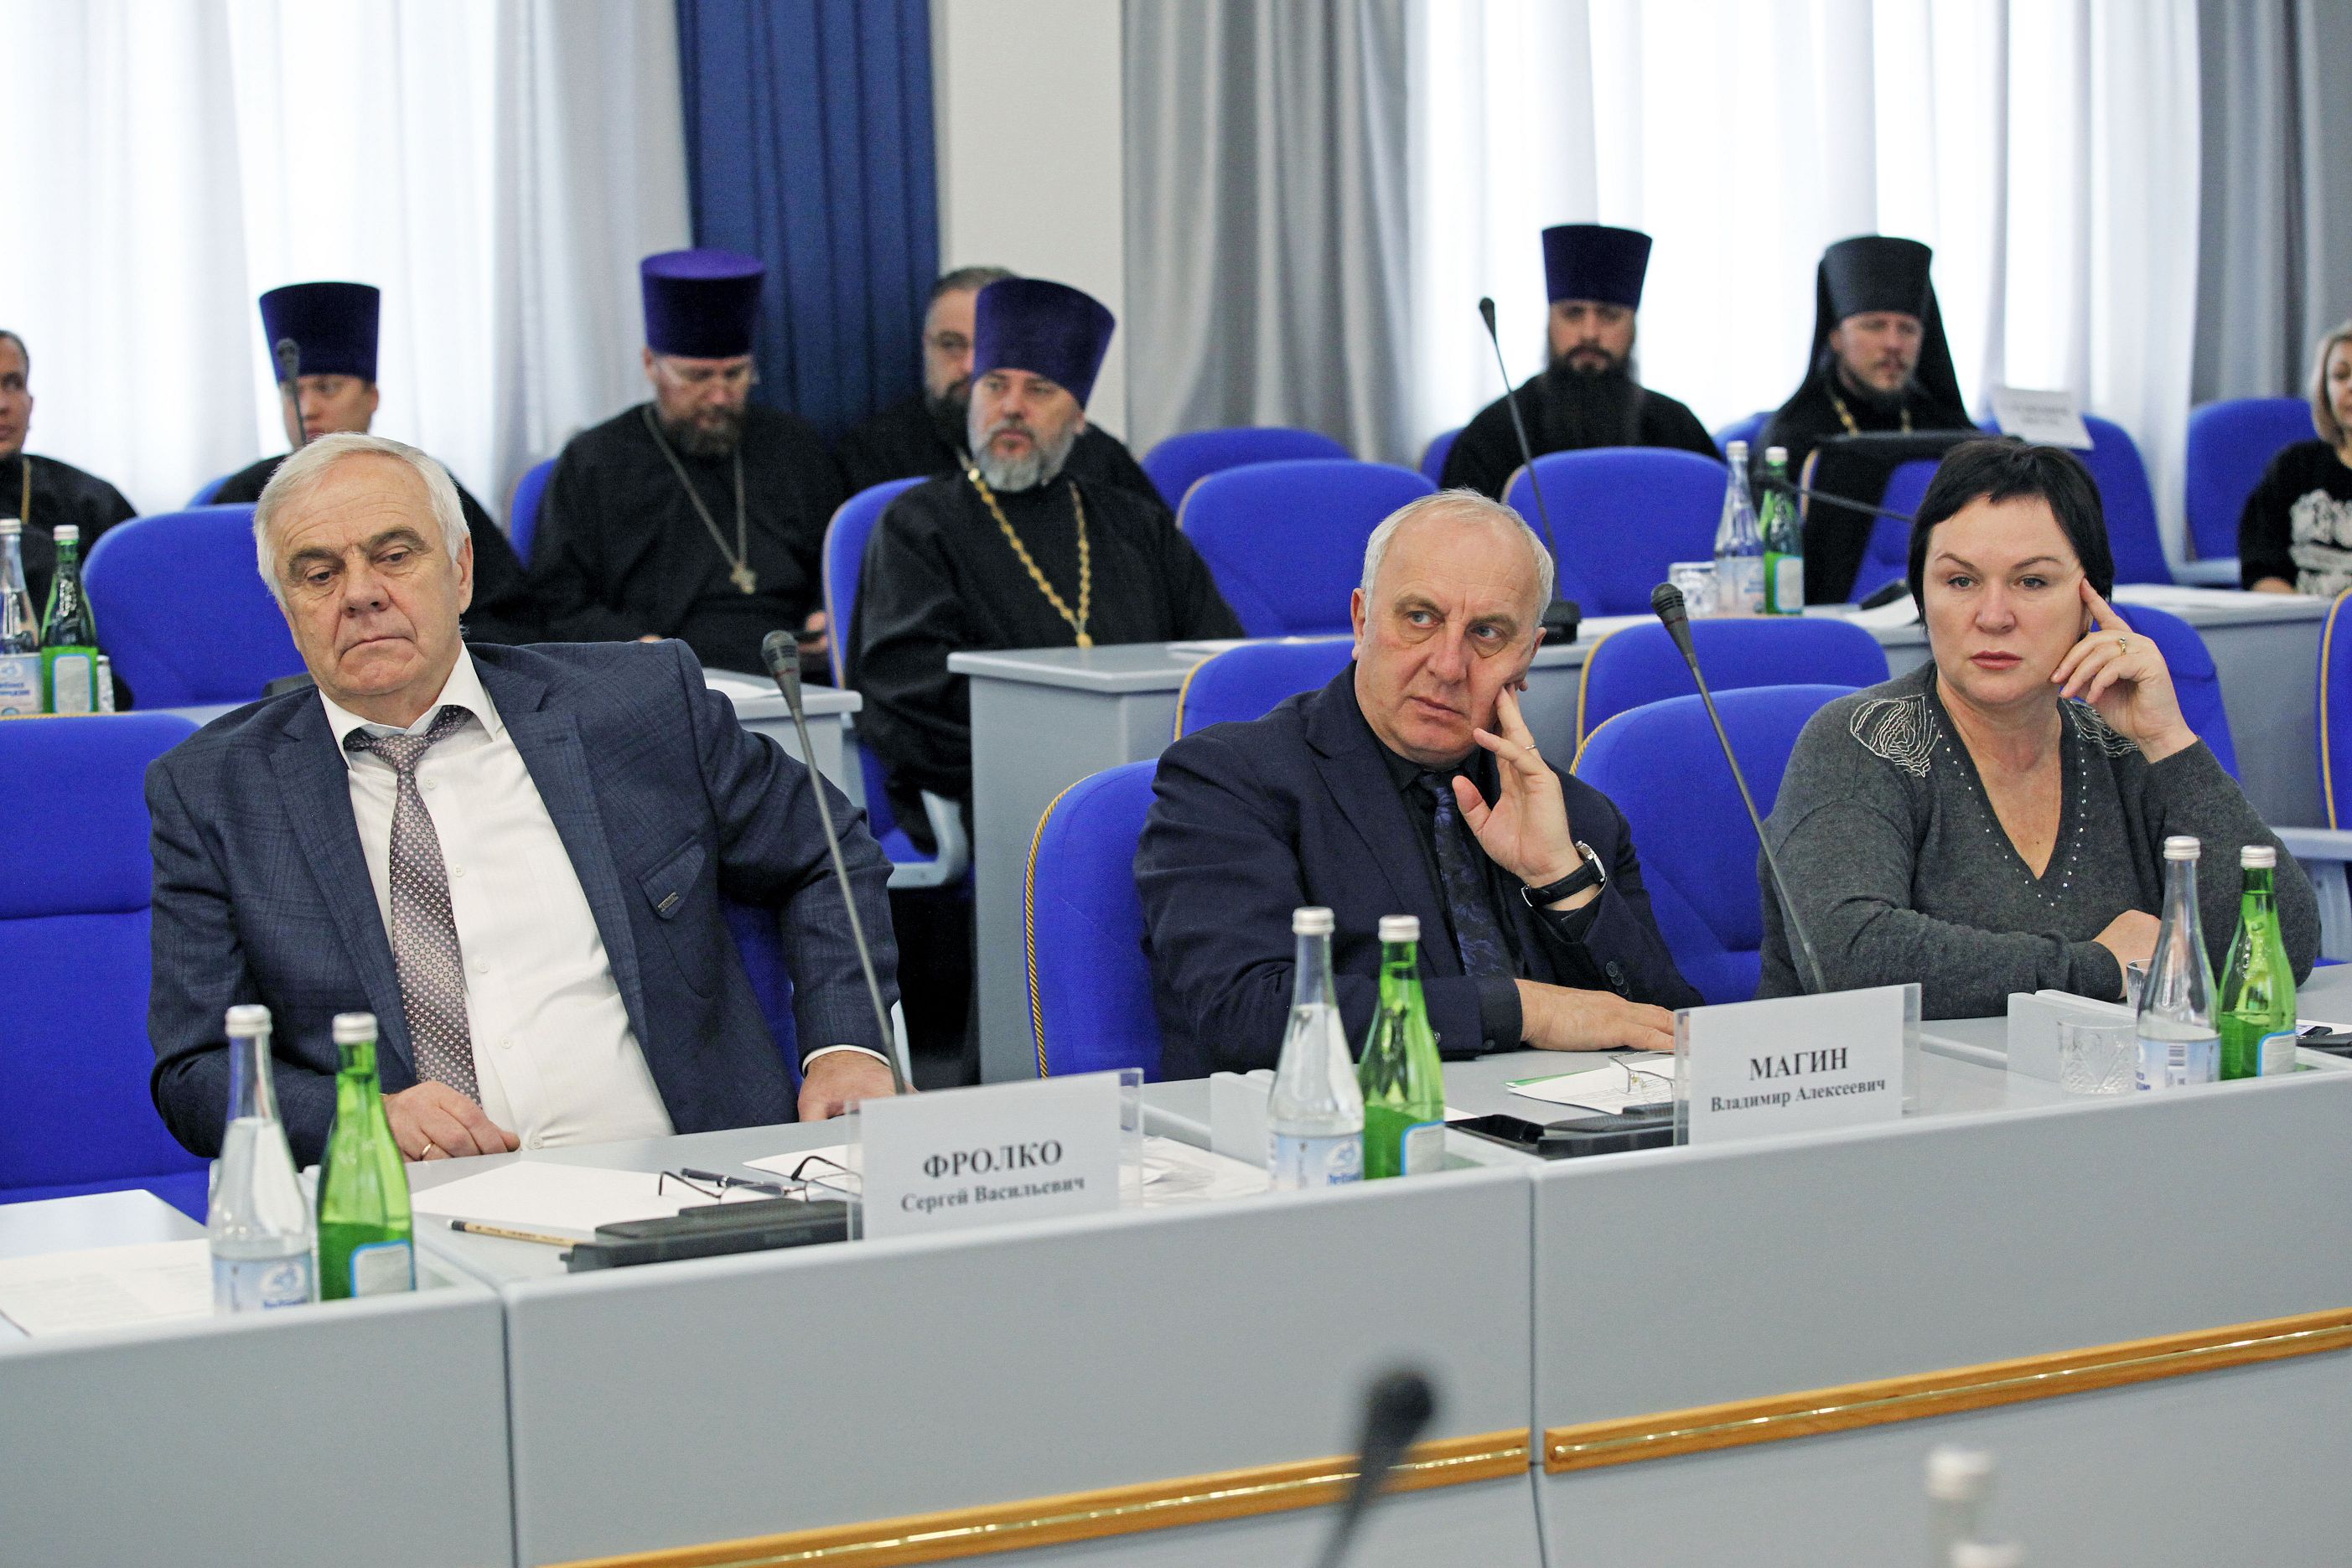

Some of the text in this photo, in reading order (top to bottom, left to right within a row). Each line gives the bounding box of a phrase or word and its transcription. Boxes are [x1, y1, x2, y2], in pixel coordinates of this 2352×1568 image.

[1749, 1048, 1848, 1081] МАГИН
[1711, 1079, 1885, 1112] Владимир Алексеевич
[924, 1139, 1063, 1178] ФРОЛКО
[901, 1177, 1085, 1214] Сергей Васильевич
